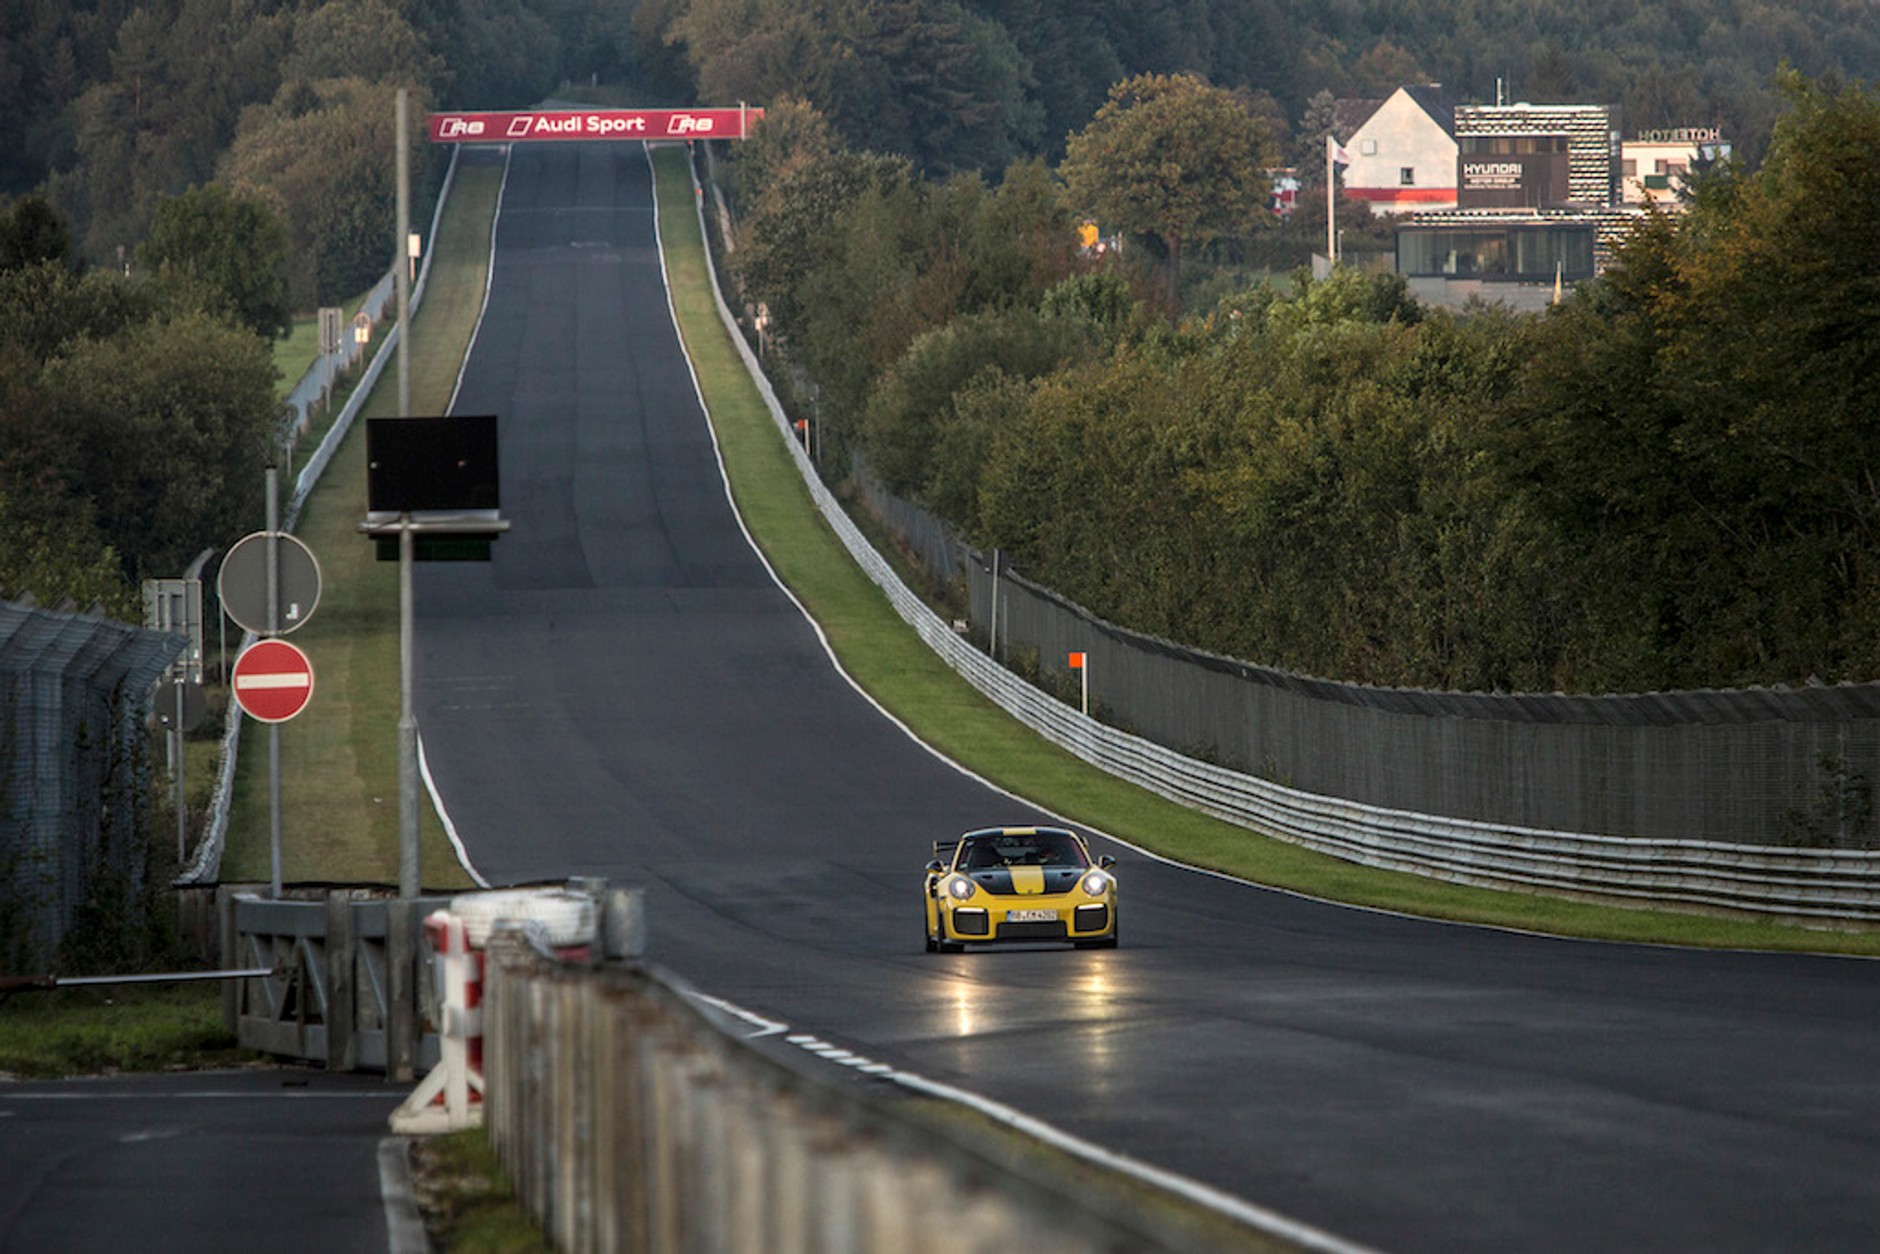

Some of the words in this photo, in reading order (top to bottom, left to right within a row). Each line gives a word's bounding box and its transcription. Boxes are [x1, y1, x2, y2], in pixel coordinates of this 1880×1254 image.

[534, 116, 582, 132] Audi
[586, 115, 646, 135] Sport
[1463, 163, 1523, 175] HYUNDAI
